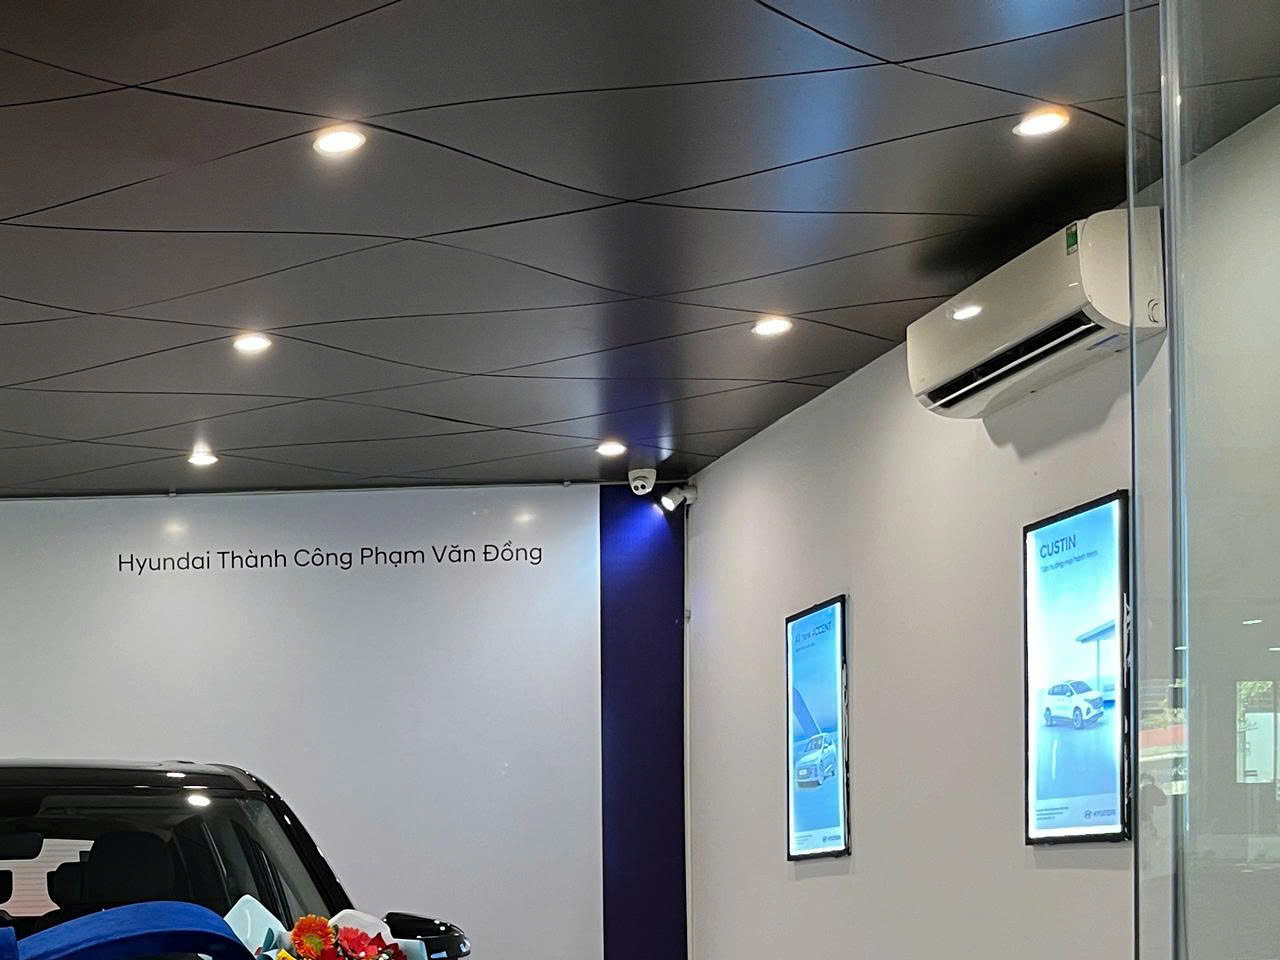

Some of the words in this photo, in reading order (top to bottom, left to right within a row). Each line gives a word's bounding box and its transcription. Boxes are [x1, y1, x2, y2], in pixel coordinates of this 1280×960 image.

[118, 551, 211, 576] Hyundai
[217, 549, 287, 569] Thành
[294, 548, 353, 571] Công
[361, 546, 425, 568] Phạm
[432, 544, 476, 563] Văn
[483, 540, 543, 565] Đồng
[1040, 534, 1076, 558] CUSTIN
